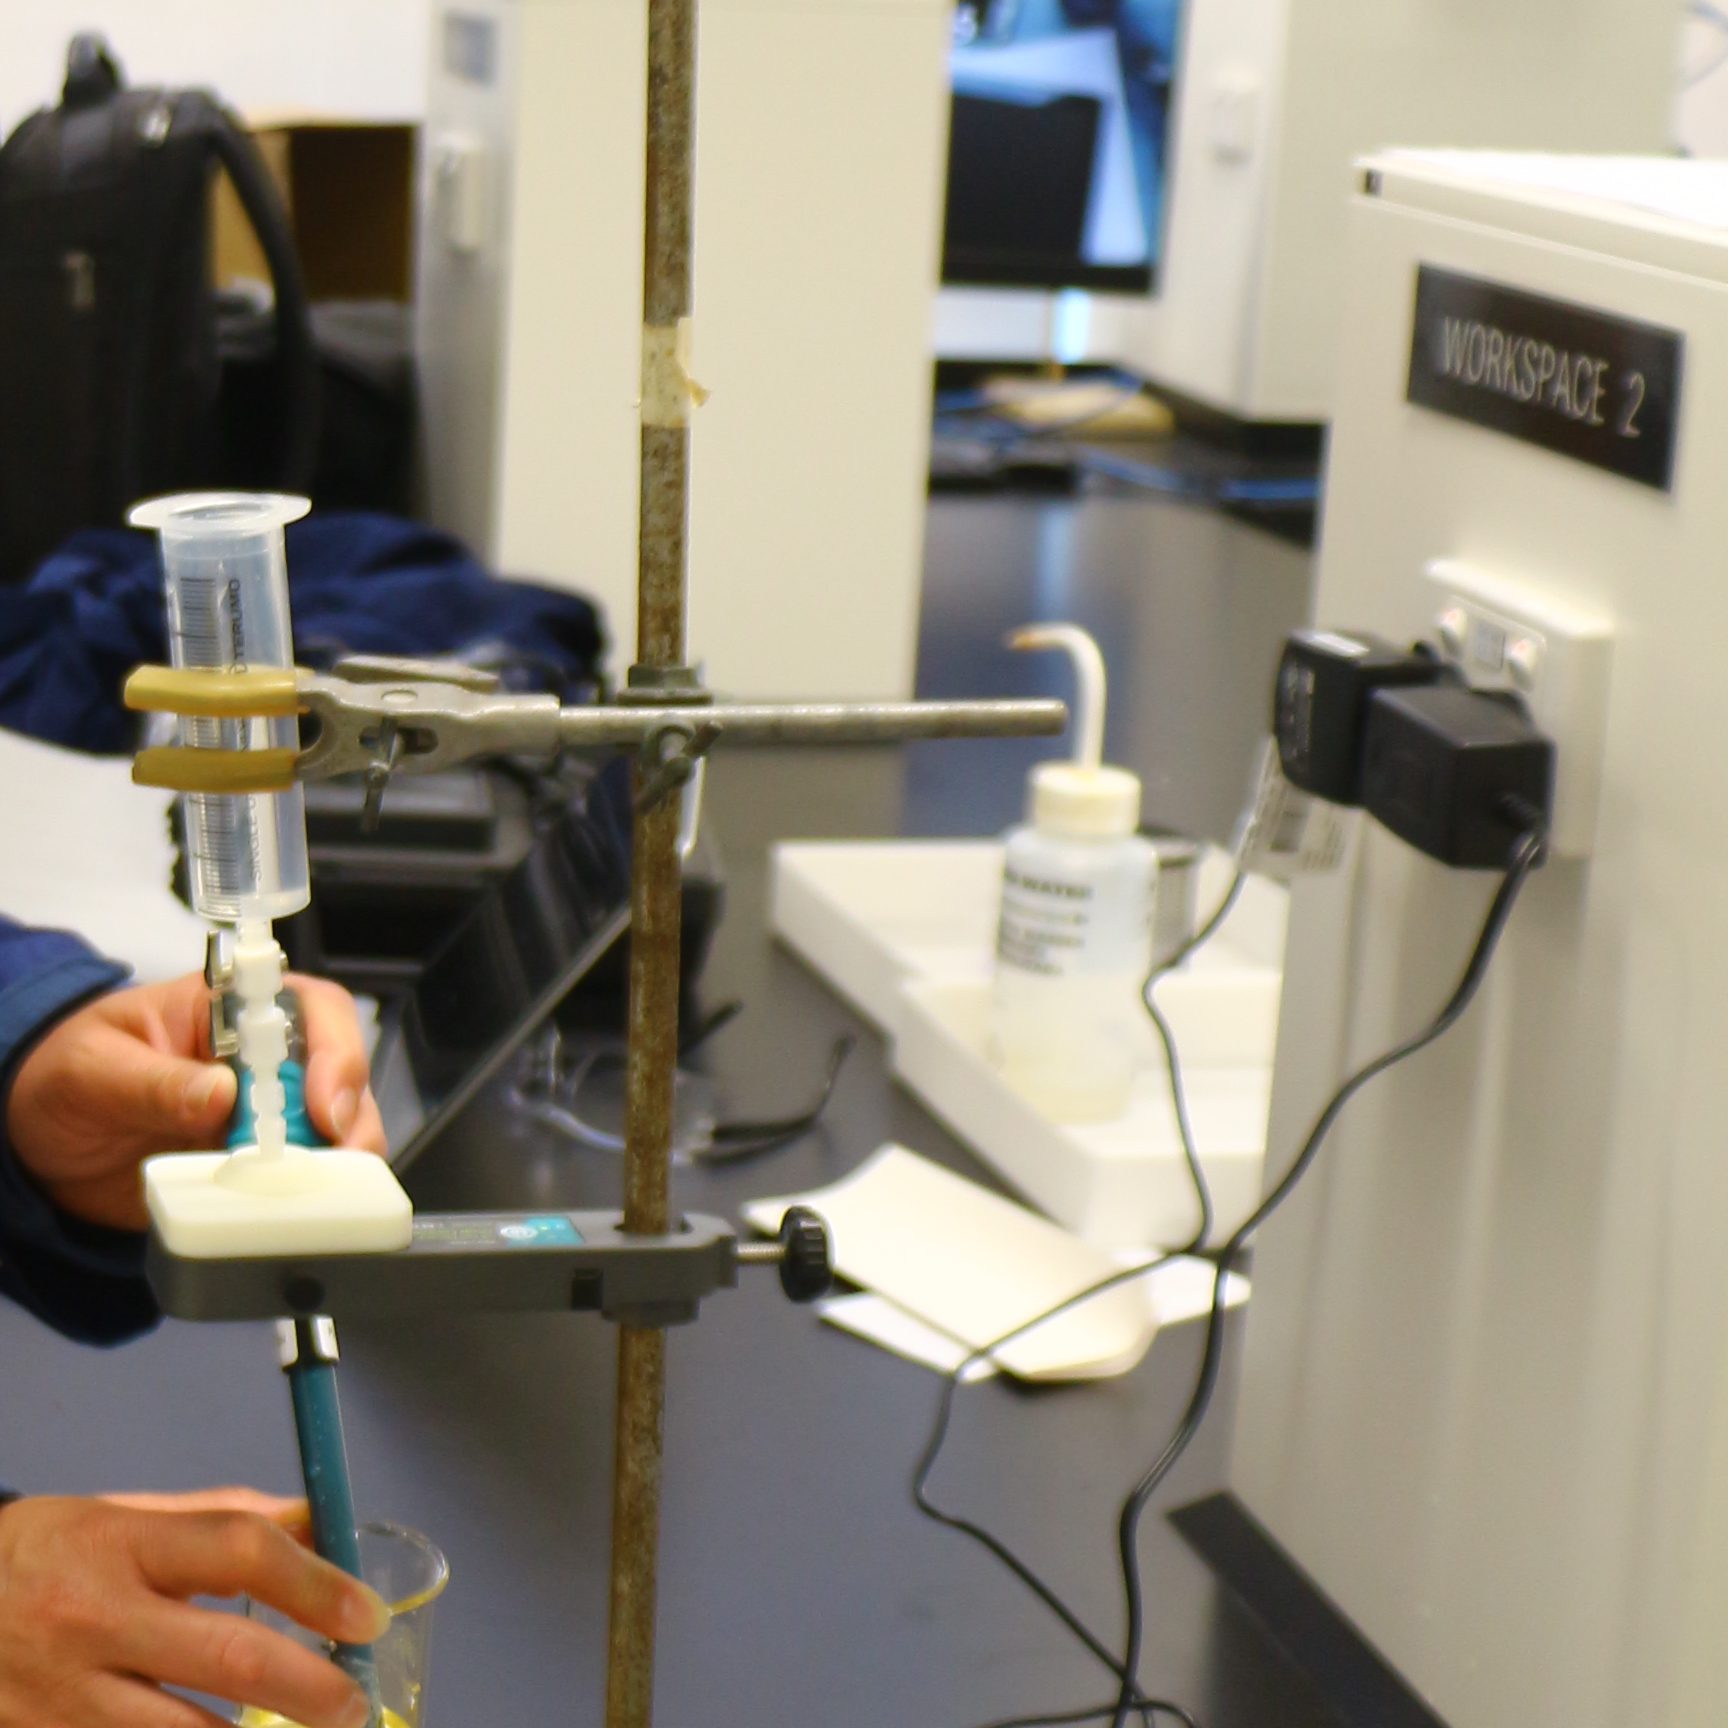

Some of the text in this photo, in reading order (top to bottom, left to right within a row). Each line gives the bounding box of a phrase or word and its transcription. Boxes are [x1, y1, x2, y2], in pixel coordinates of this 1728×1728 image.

[1444, 316, 1646, 439] WORKSPACE 2
[228, 578, 245, 660] TERUMO
